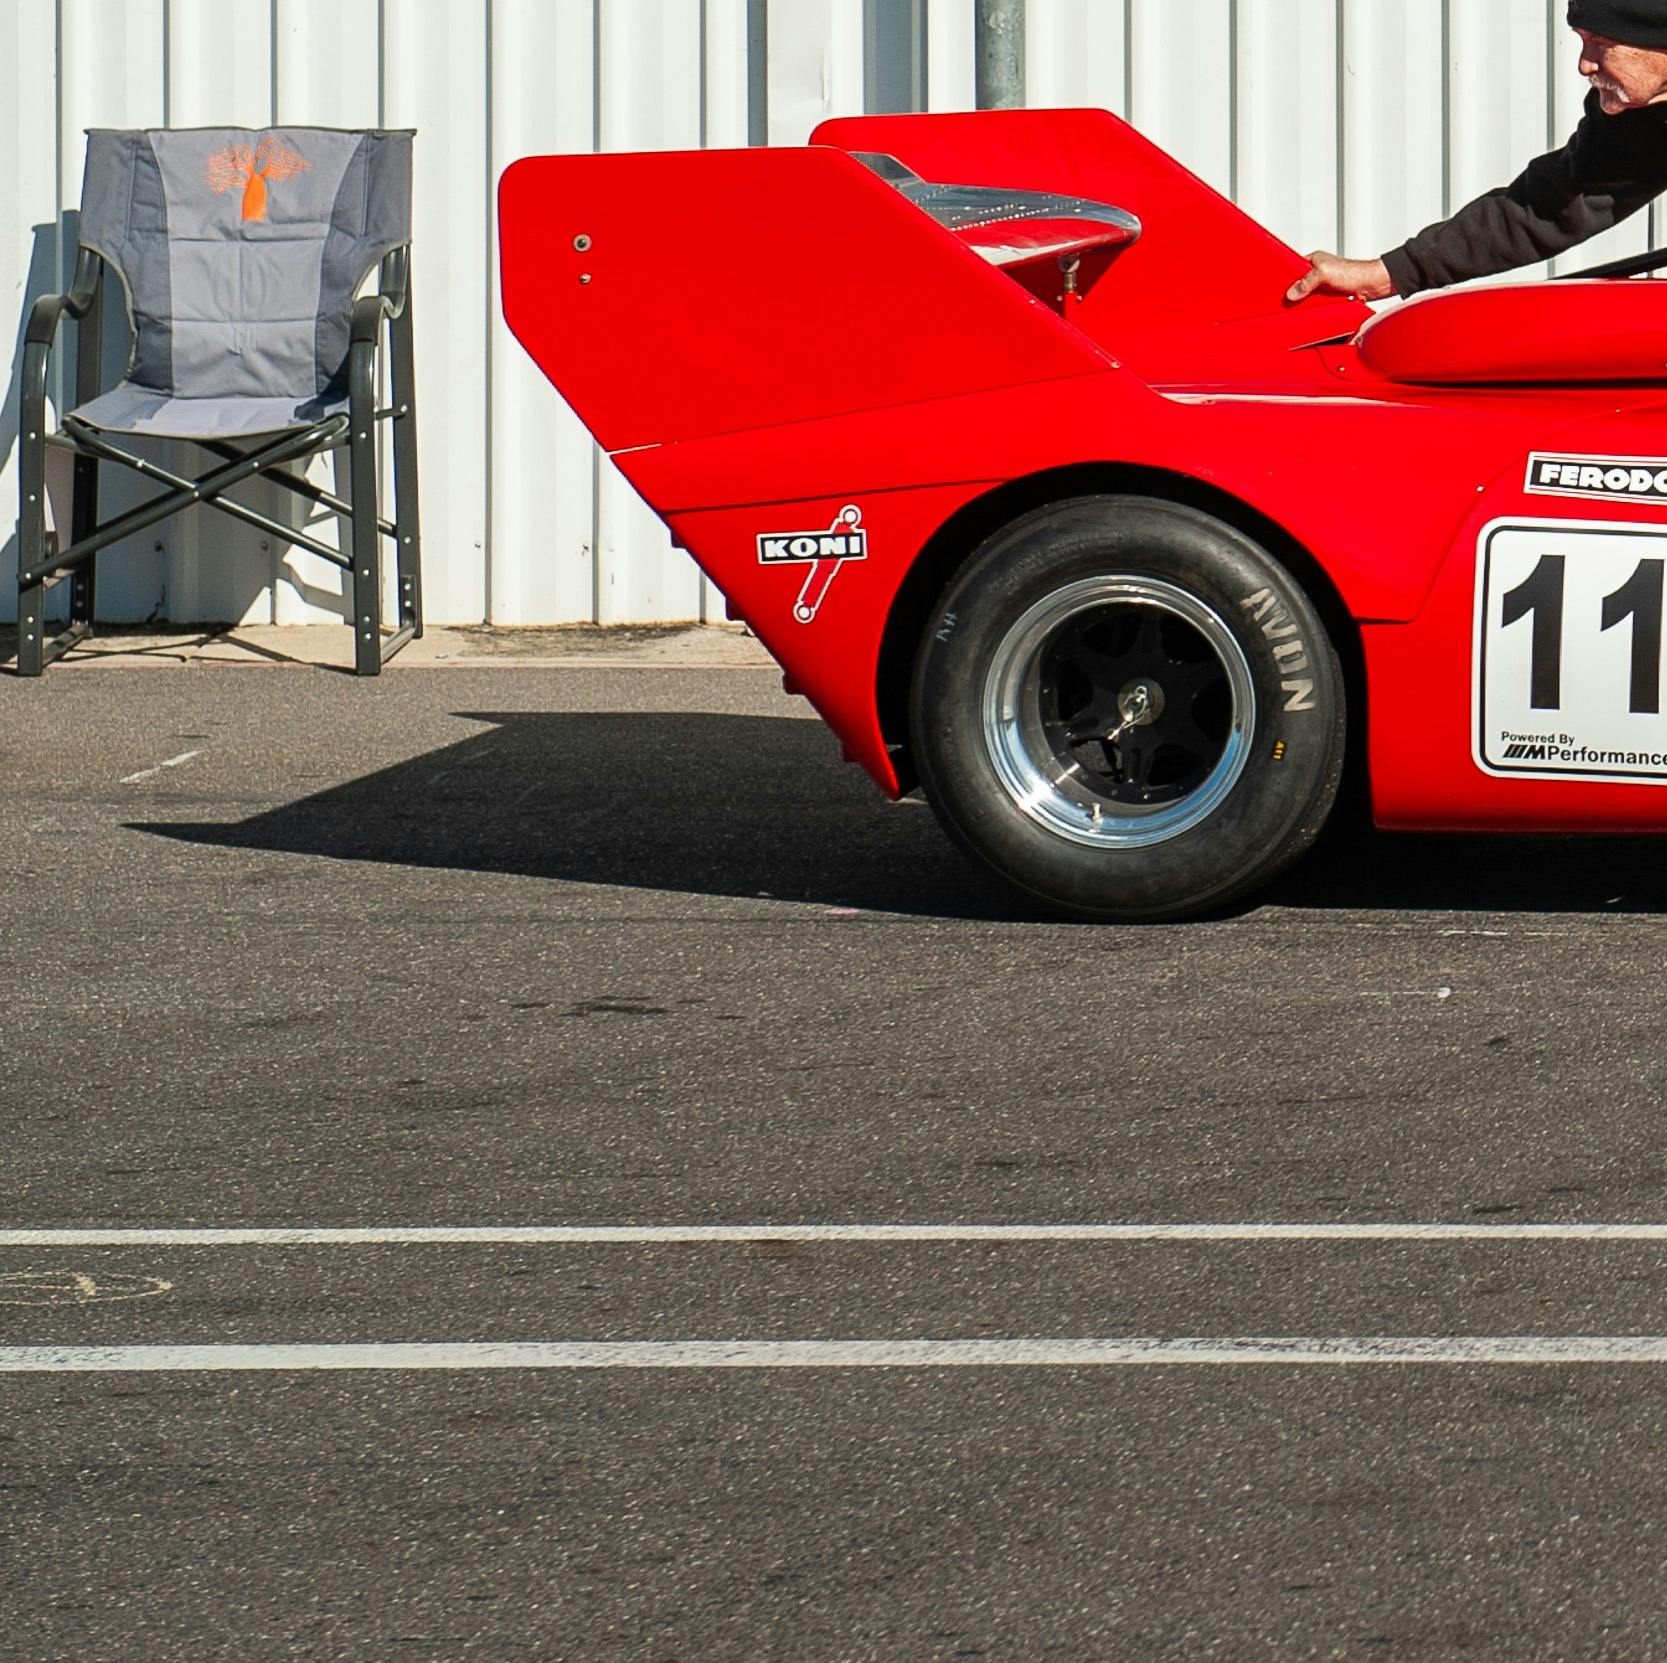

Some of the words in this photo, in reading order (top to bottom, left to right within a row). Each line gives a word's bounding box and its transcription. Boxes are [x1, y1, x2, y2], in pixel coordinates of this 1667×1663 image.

[763, 535, 861, 558] KONI
[1240, 586, 1316, 714] AVON
[1500, 553, 1666, 715] 11
[1501, 730, 1556, 744] Powered
[1559, 732, 1576, 746] By
